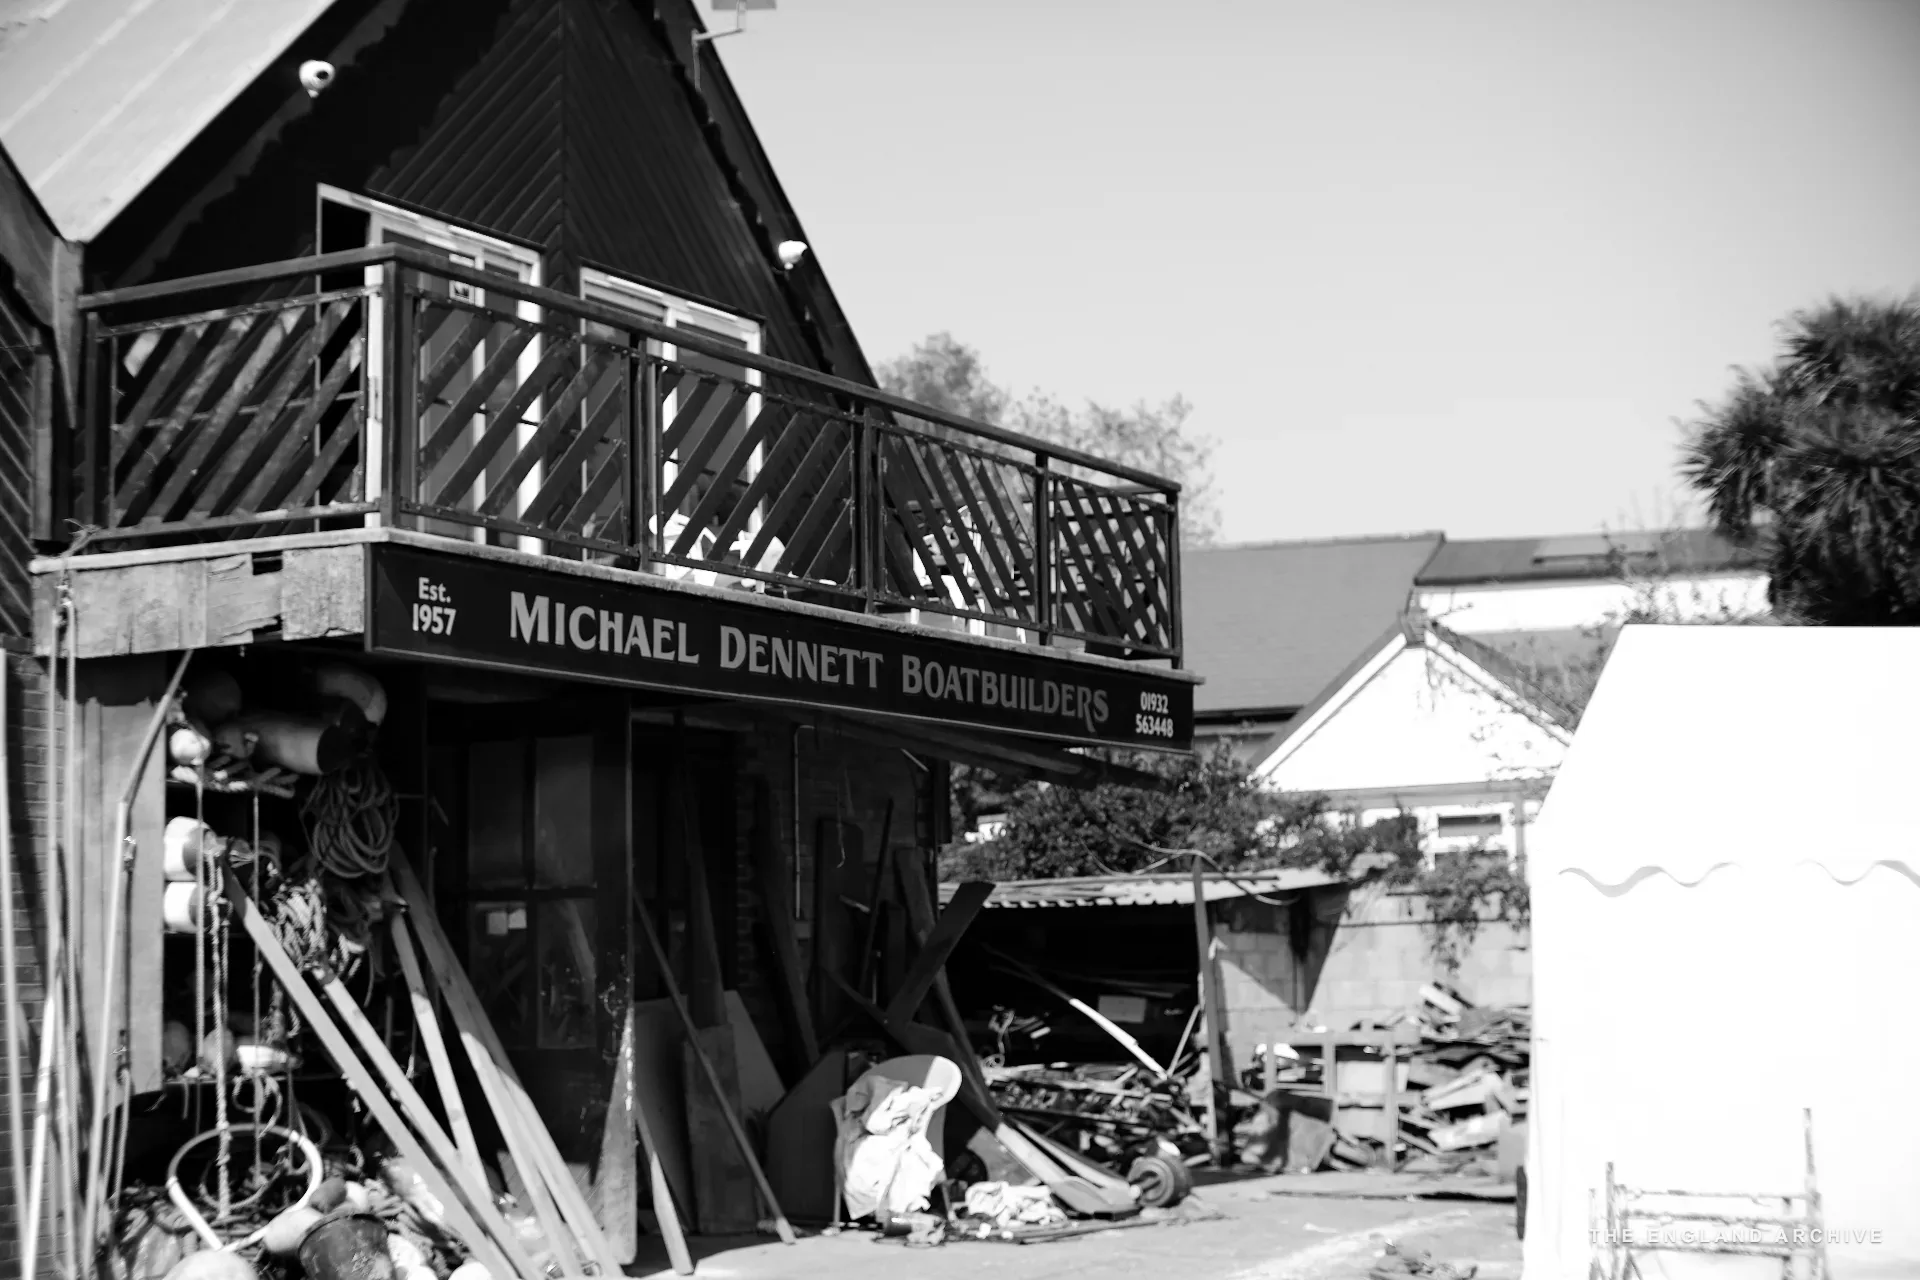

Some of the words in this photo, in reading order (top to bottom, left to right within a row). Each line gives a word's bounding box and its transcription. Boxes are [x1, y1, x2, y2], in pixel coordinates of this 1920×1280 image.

[418, 577, 451, 603] Est.
[412, 604, 456, 636] 1957
[510, 591, 699, 664] MICHAEL
[720, 625, 884, 688] DENNETT
[902, 655, 1110, 733] BOATBUILDERS
[1140, 691, 1169, 715] 01932
[1135, 714, 1174, 738] 563448
